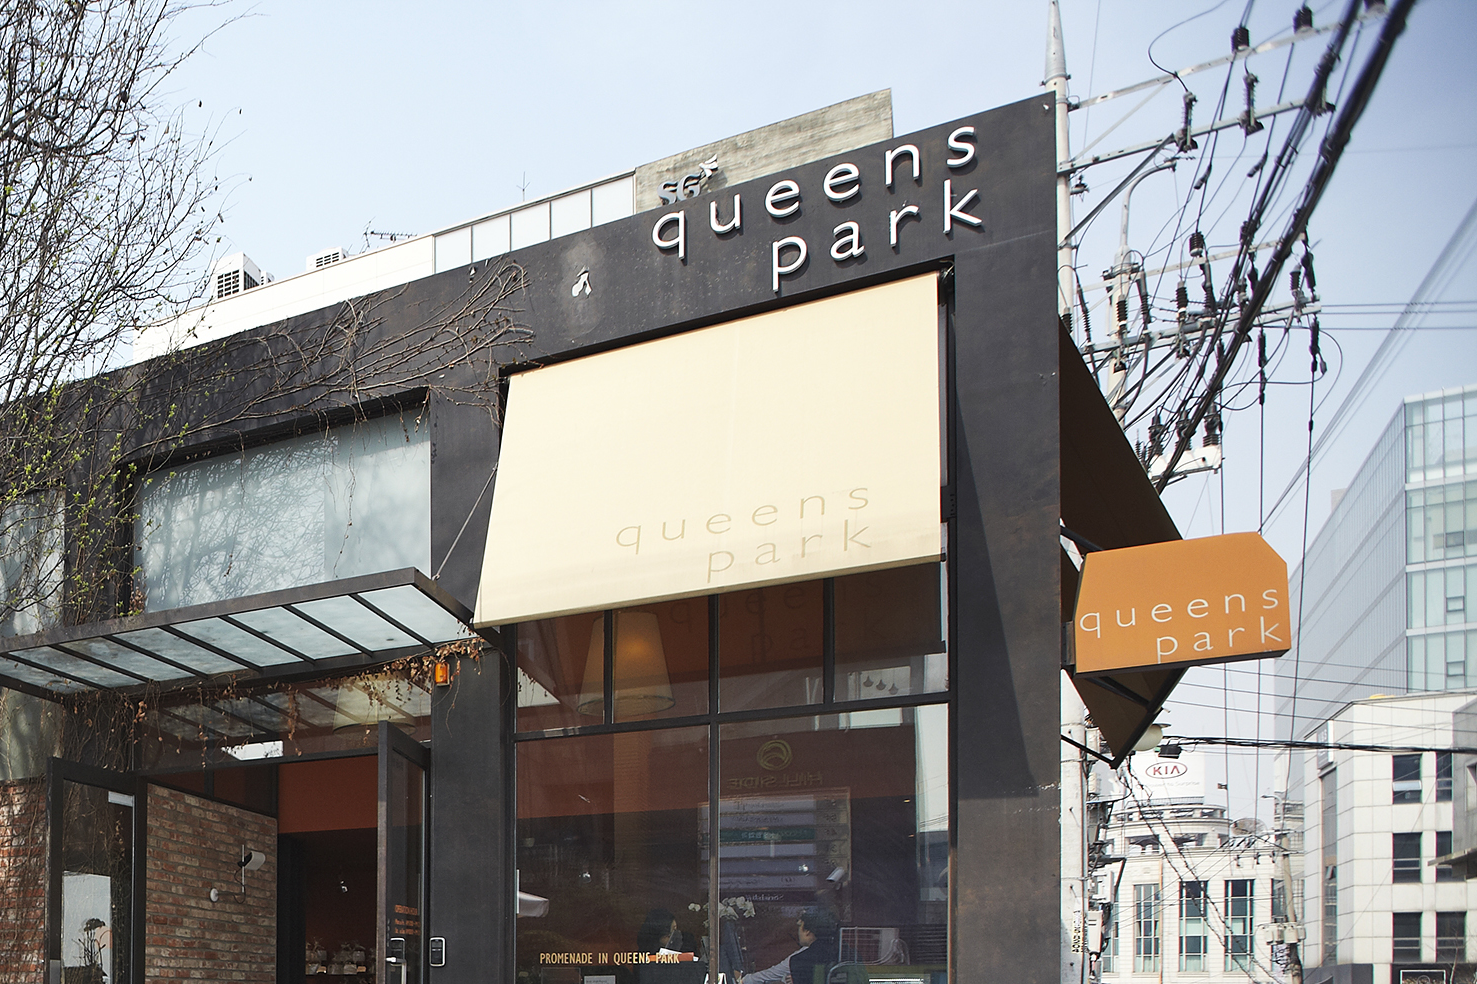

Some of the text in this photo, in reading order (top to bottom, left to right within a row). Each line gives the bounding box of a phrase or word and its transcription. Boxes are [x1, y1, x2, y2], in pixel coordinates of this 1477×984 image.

[652, 125, 976, 260] queens
[772, 179, 983, 292] park
[615, 487, 869, 555] queens
[707, 519, 871, 583] park
[1079, 589, 1278, 638] queens
[1157, 616, 1282, 664] park
[1153, 765, 1180, 775] KIA
[540, 952, 680, 966] PROMENADE IN QUEENS PARK
